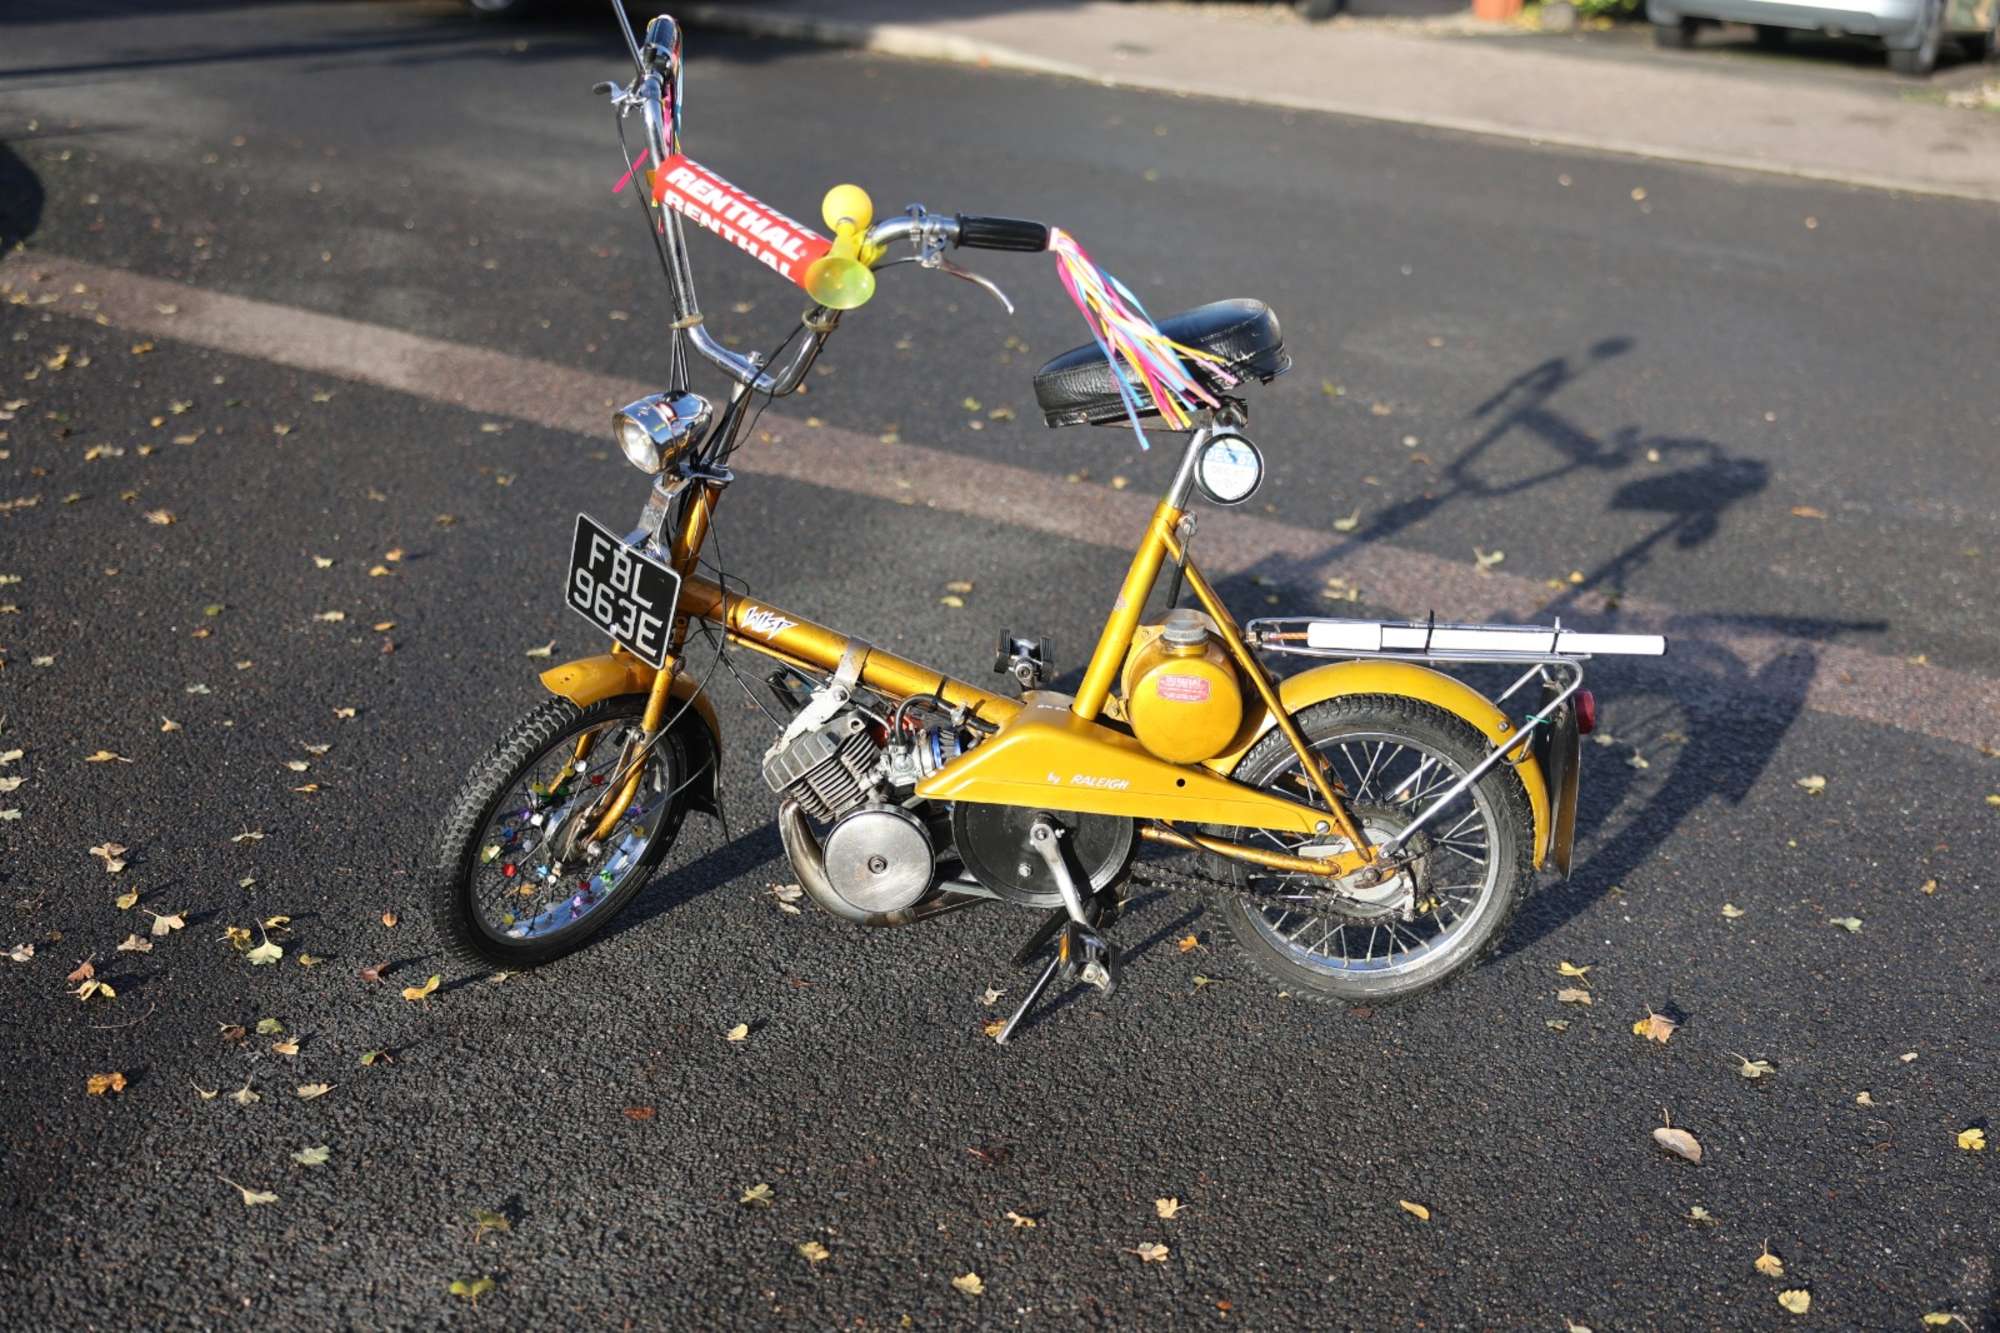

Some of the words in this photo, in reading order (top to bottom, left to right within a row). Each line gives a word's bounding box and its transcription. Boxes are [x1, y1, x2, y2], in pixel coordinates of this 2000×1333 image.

[664, 190, 796, 283] RENTHAL
[665, 167, 801, 261] RENTHAL
[573, 567, 663, 657] 963E
[588, 533, 653, 610] FBL
[1070, 774, 1130, 790] RALEIGH
